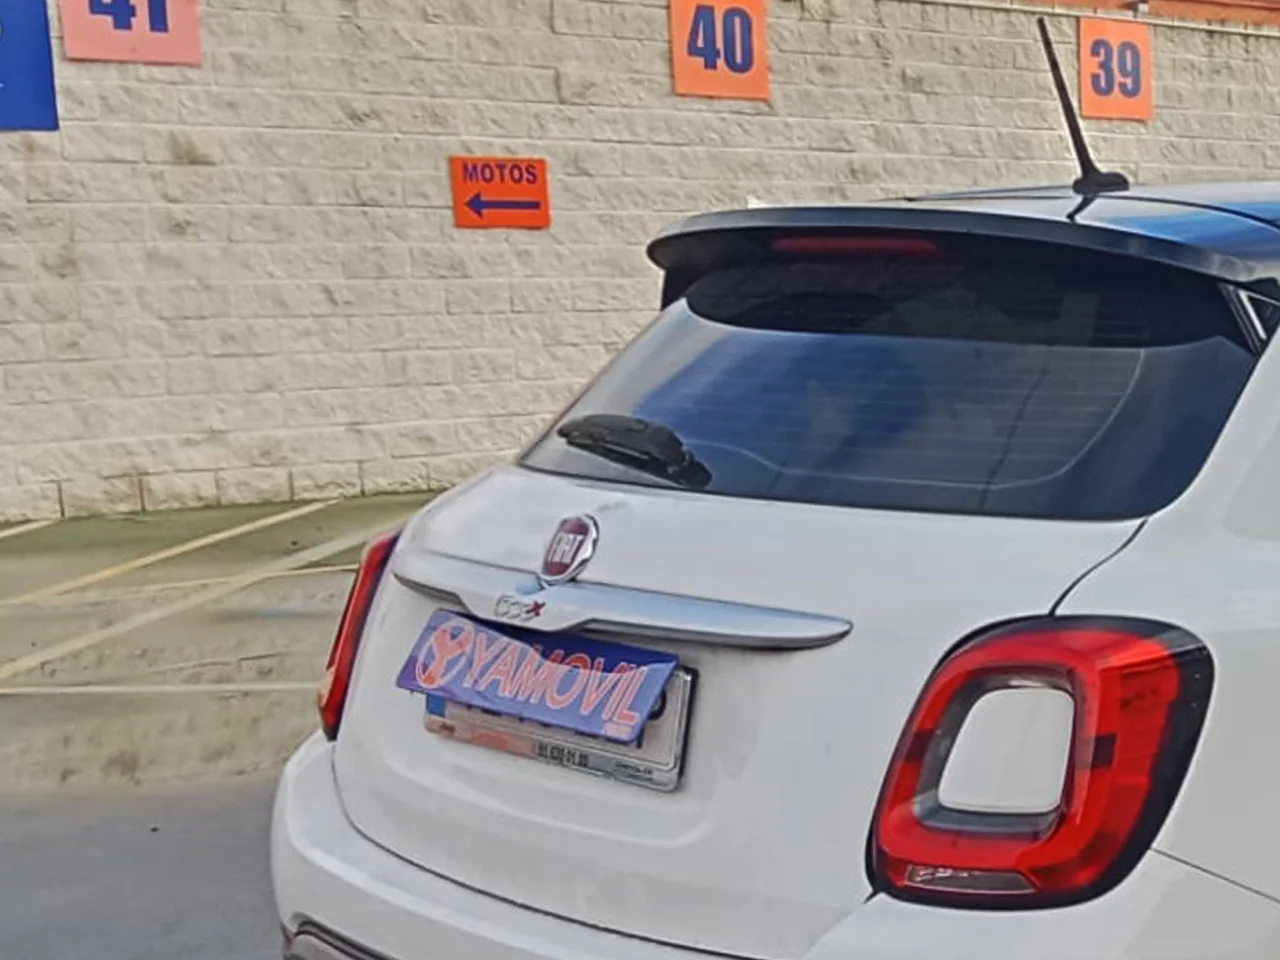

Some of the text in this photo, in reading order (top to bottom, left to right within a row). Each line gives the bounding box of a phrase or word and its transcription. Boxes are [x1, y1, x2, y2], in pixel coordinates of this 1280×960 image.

[687, 4, 754, 74] 40
[1089, 38, 1142, 98] 39
[462, 161, 538, 185] MOTOS
[546, 531, 586, 564] FIAT
[463, 632, 648, 724] YAMOVIL
